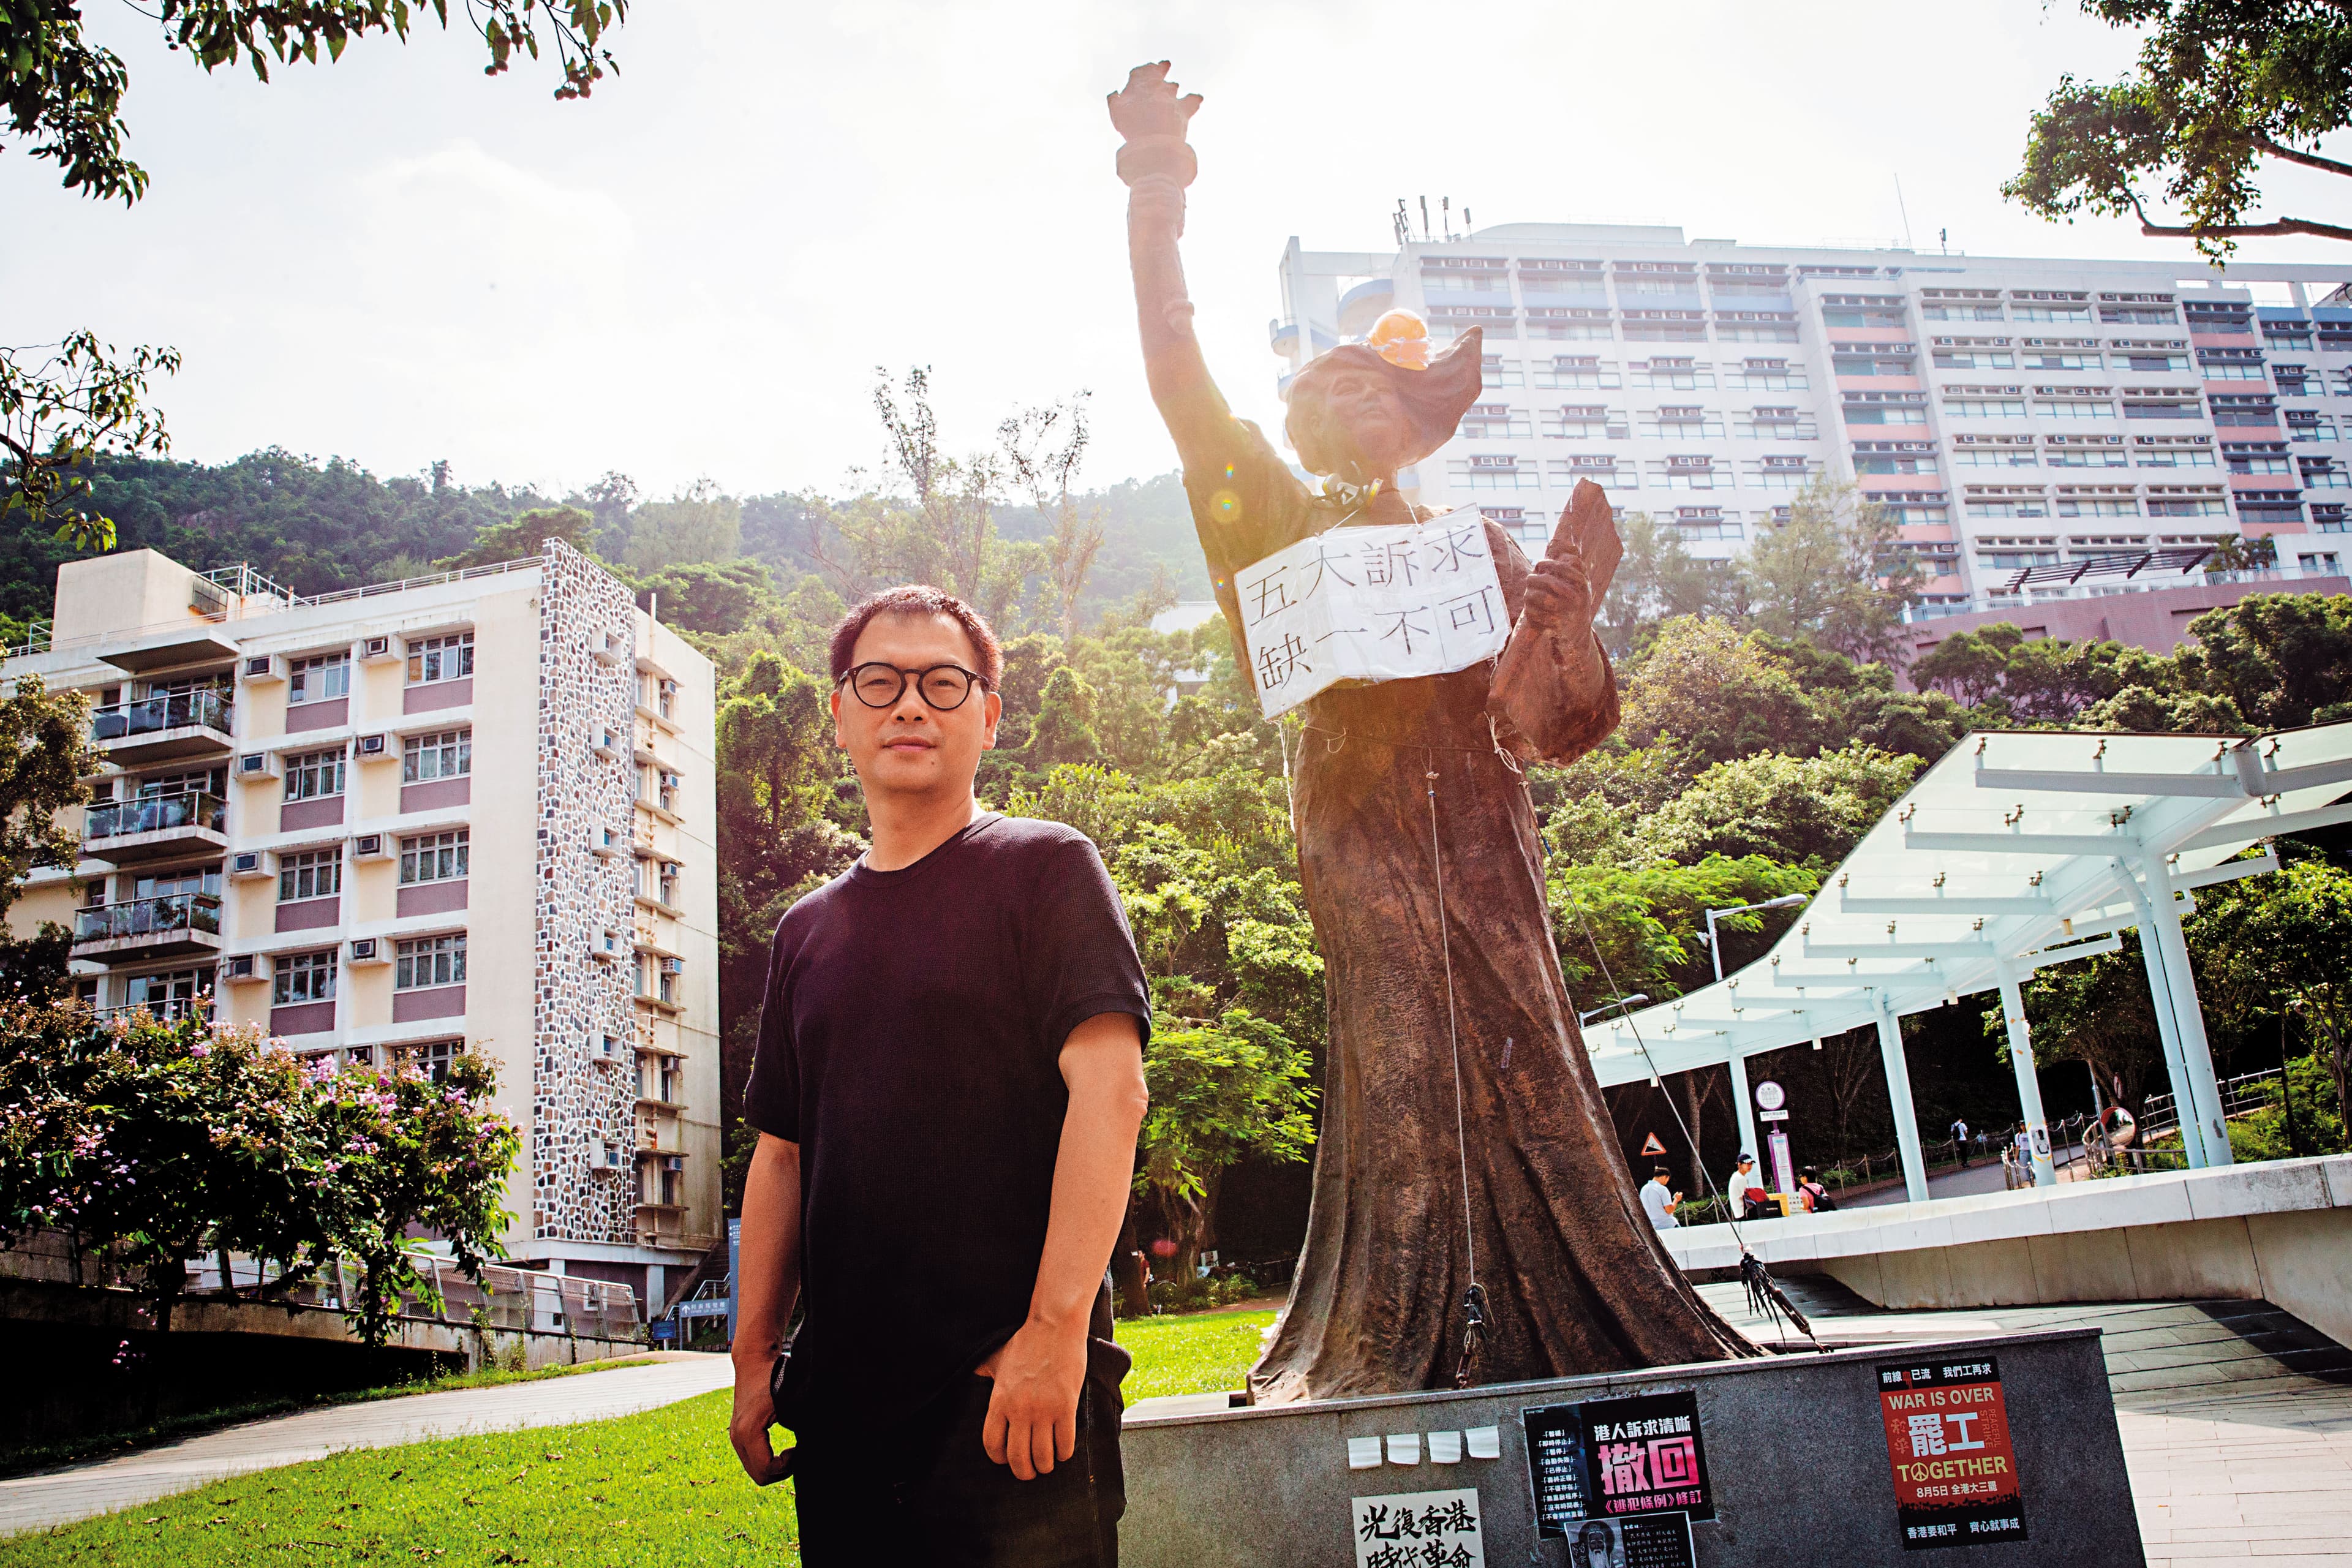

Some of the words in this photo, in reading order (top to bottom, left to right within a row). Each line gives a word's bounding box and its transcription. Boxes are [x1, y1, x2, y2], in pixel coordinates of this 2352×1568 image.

[1246, 526, 1484, 626] 五大訴求
[1258, 585, 1493, 690] 缺一不可
[1882, 1368, 1931, 1387] 前線血已流
[1942, 1363, 1992, 1378] 我們工再求
[1888, 1393, 1926, 1410] WAR
[1931, 1392, 1946, 1406] IS
[1950, 1387, 1995, 1404] OVER
[1594, 1415, 1691, 1441] 港人訴求清晰
[1907, 1411, 1985, 1458] 罷工
[1980, 1410, 1994, 1449] STRIKE
[1989, 1409, 2002, 1448] PEACEFUL
[1598, 1436, 1700, 1495] 撤回
[1917, 1485, 1948, 1498] 8月5日
[1951, 1480, 1998, 1495] 全港大三罷
[1359, 1499, 1477, 1542] 光復香港
[1907, 1523, 1958, 1539] 香港要和平
[1969, 1517, 2020, 1534] 齊心就事成
